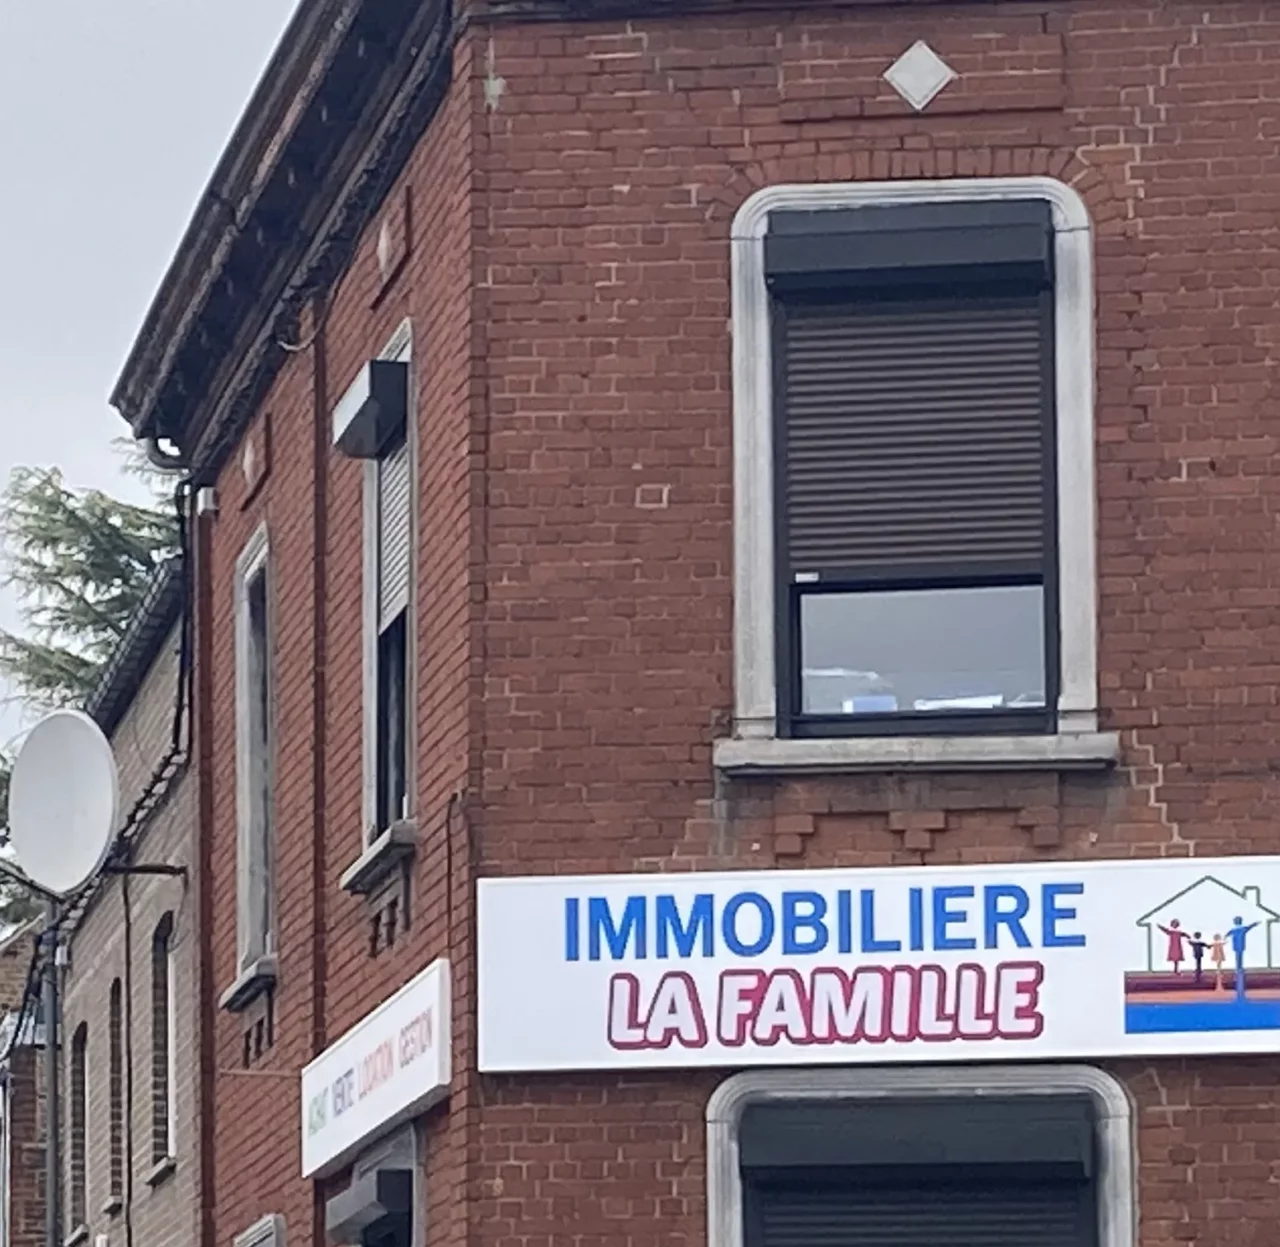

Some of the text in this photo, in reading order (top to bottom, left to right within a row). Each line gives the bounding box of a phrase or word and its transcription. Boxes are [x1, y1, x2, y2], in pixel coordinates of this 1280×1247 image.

[565, 883, 1086, 961] IMMOBILIERE
[607, 961, 1045, 1050] LA FAMILLE
